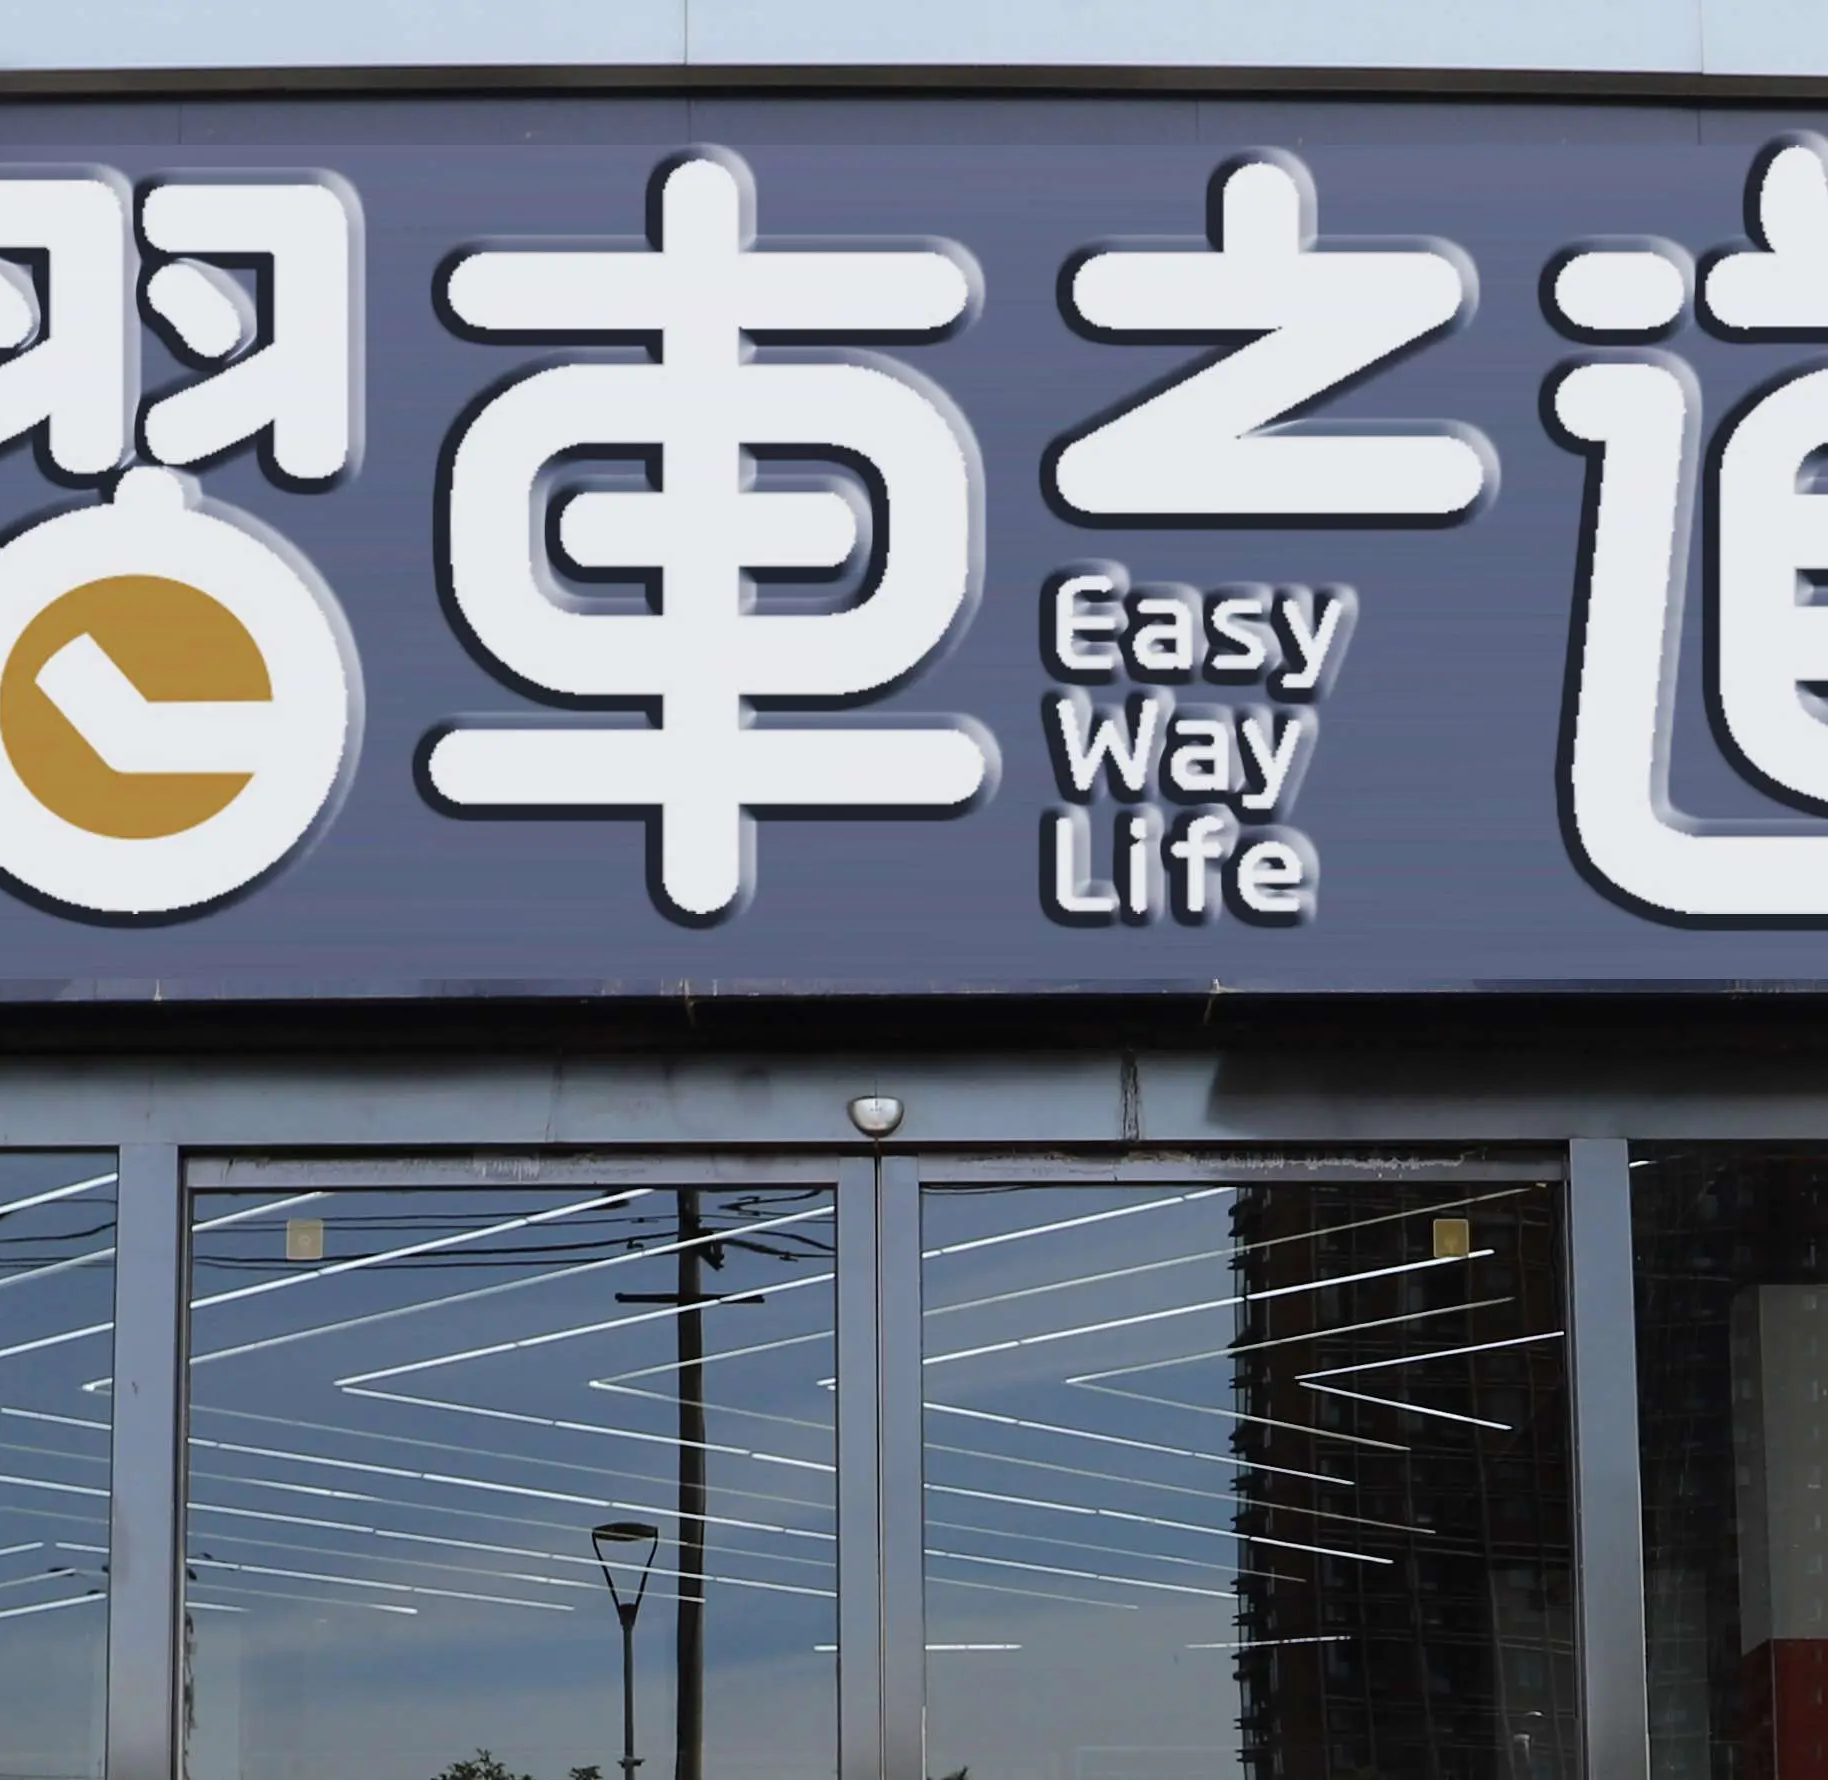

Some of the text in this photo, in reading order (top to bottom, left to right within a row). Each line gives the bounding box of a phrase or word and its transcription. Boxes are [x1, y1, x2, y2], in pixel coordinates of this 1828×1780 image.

[1052, 572, 1347, 691] Easy
[1052, 696, 1306, 811] Way
[1052, 812, 1308, 917] Life
